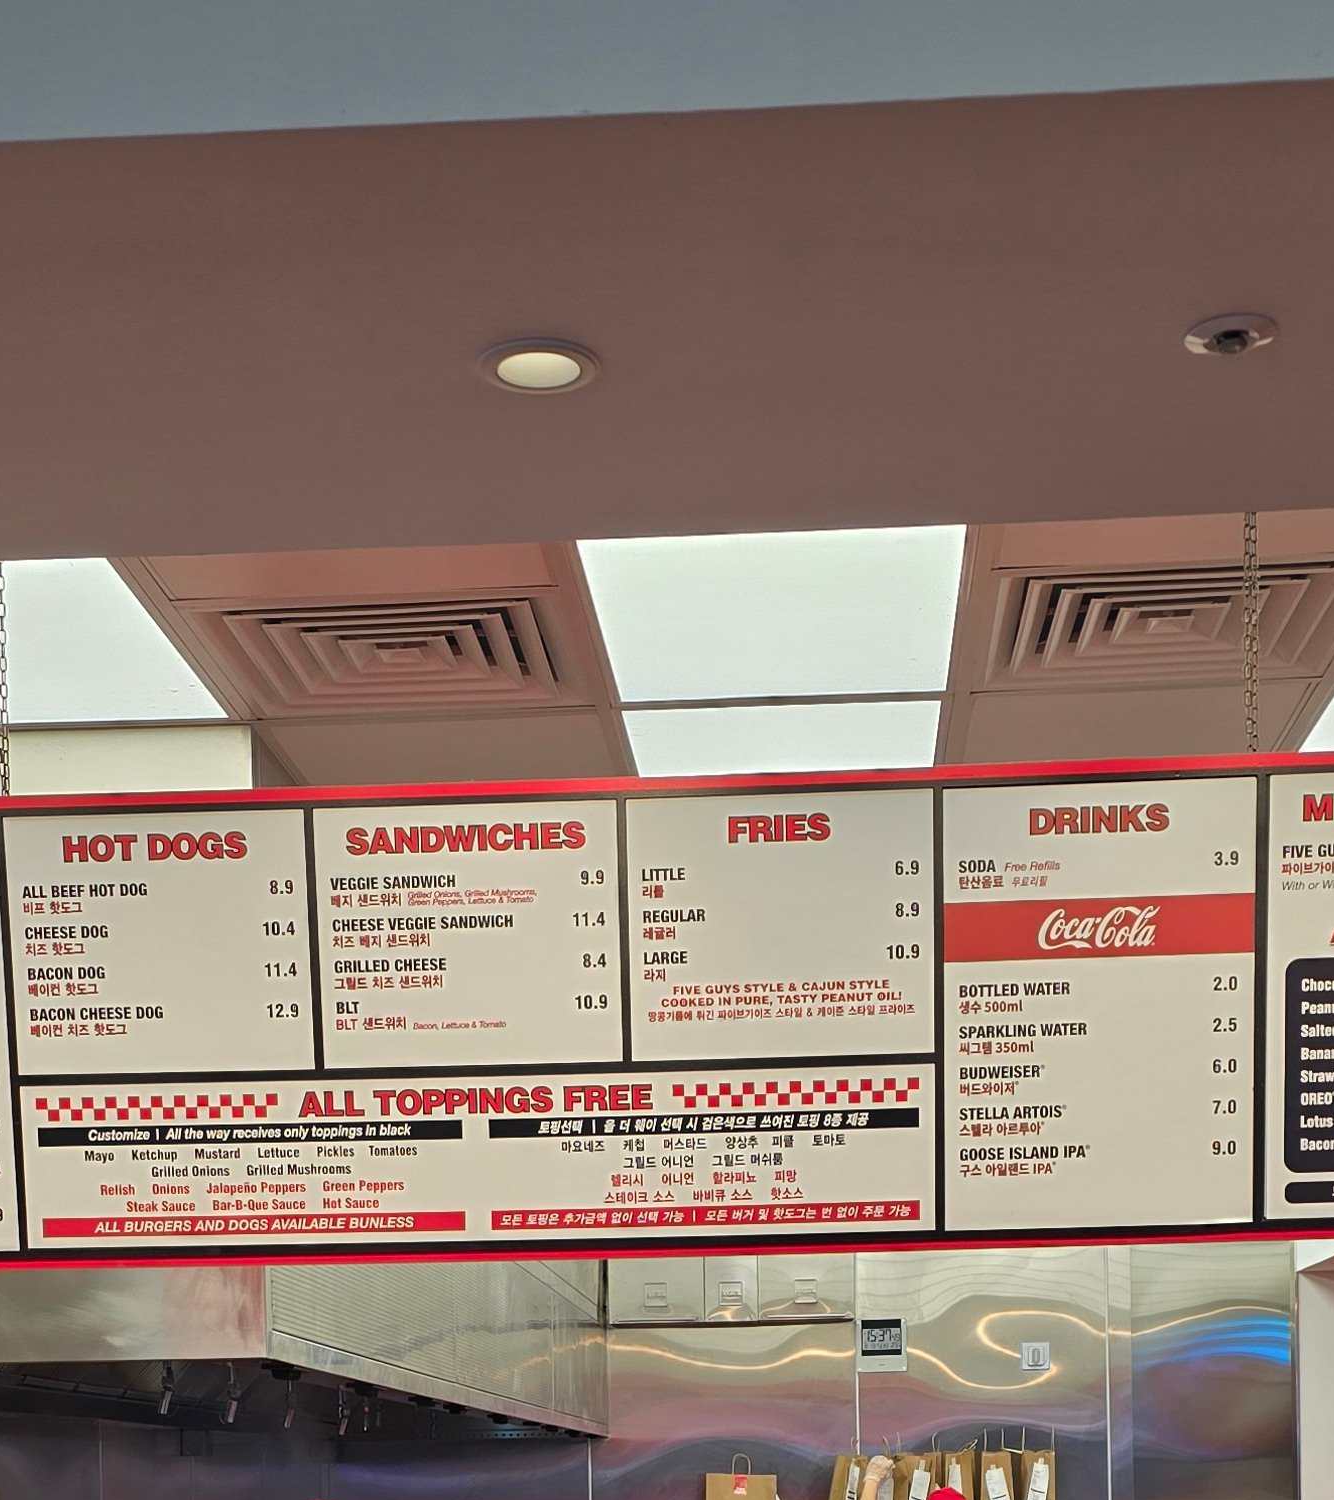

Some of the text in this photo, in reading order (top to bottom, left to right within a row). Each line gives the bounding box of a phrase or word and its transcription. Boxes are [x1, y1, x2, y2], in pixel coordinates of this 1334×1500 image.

[1027, 803, 1171, 836] DRINKS
[726, 812, 833, 844] FRIES
[344, 820, 588, 857] SANDWICHES
[60, 829, 249, 864] HOT DOGS
[1282, 844, 1312, 858] FIVE
[1214, 850, 1239, 866] 3.9
[895, 860, 919, 875] 6.9
[958, 859, 996, 873] SODA
[641, 867, 685, 881] LITTLE
[269, 879, 293, 894] 8.9
[329, 874, 455, 890] VEGGIE SANDWICH
[1282, 880, 1305, 890] With
[1307, 882, 1320, 890] or
[22, 882, 147, 899] ALL BEEF HOT DOG
[642, 908, 705, 923] REGULAR
[895, 901, 919, 917] 8.9
[1037, 905, 1160, 949] Coca-Cola
[643, 950, 687, 965] LARGE
[886, 943, 919, 959] 10.9
[643, 967, 666, 982] 라지
[959, 981, 1070, 998] BOTTLED WATER
[1213, 975, 1237, 991] 2.0
[336, 1001, 359, 1014] BLT
[574, 994, 607, 1009] 10.9
[958, 999, 1023, 1014] 생수 500ml
[298, 1082, 654, 1118] ALL TOPPINGS FREE
[867, 1328, 891, 1342] 15:37
